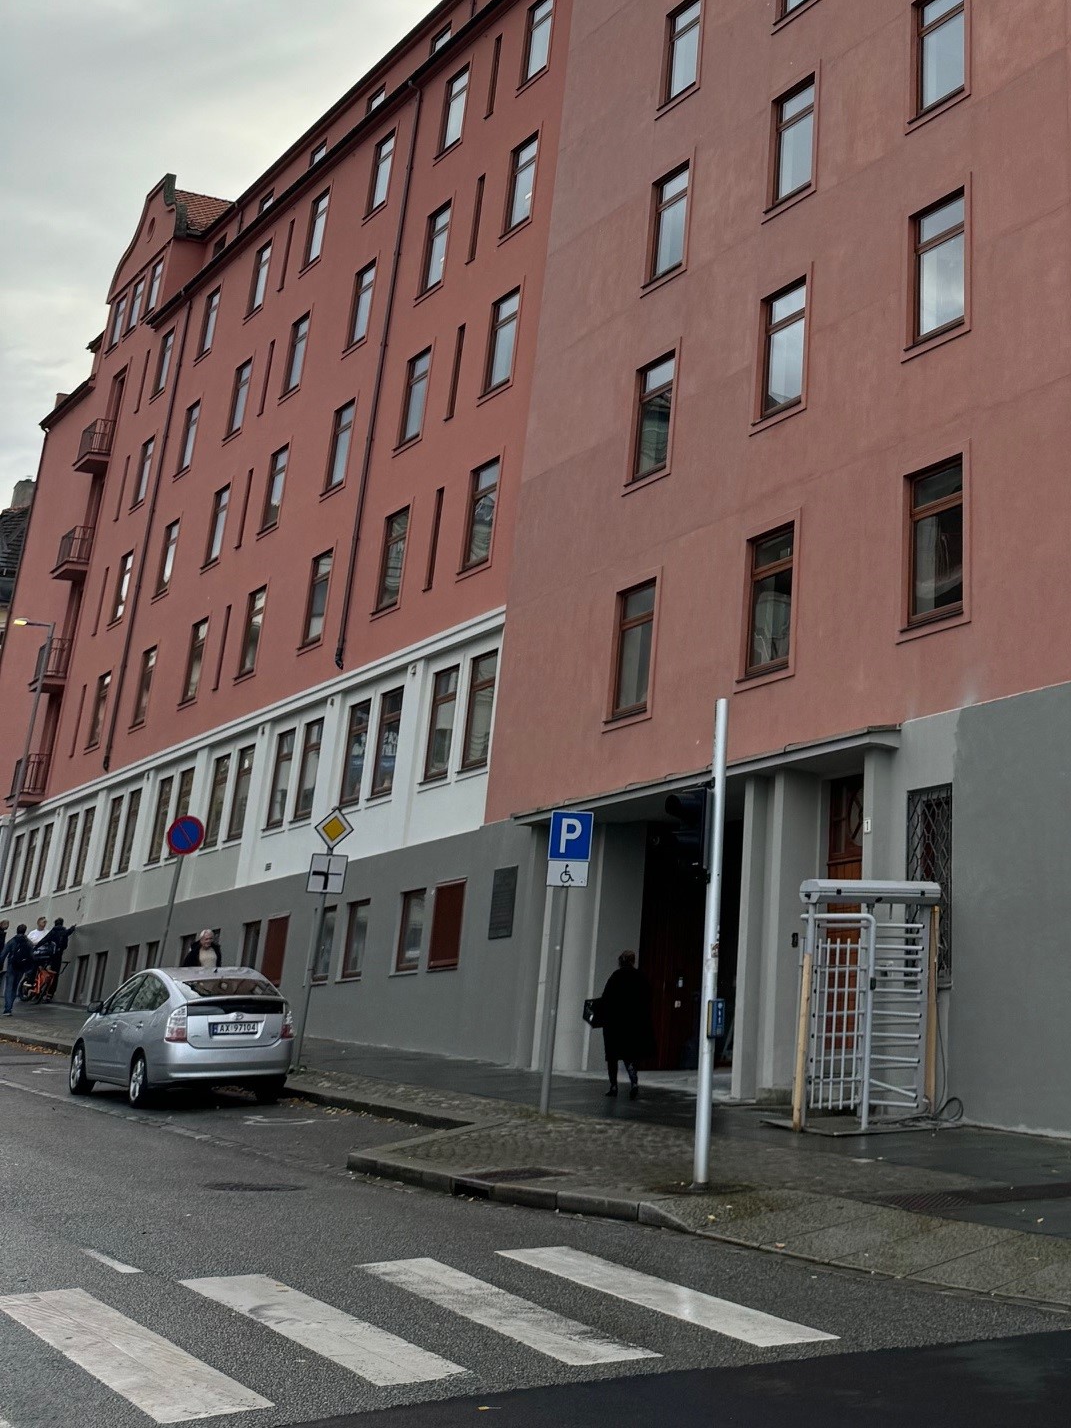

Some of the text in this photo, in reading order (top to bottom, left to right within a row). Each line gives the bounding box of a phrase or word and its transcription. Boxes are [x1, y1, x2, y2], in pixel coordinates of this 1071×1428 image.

[559, 818, 582, 853] P
[219, 1023, 256, 1032] AX 97104
